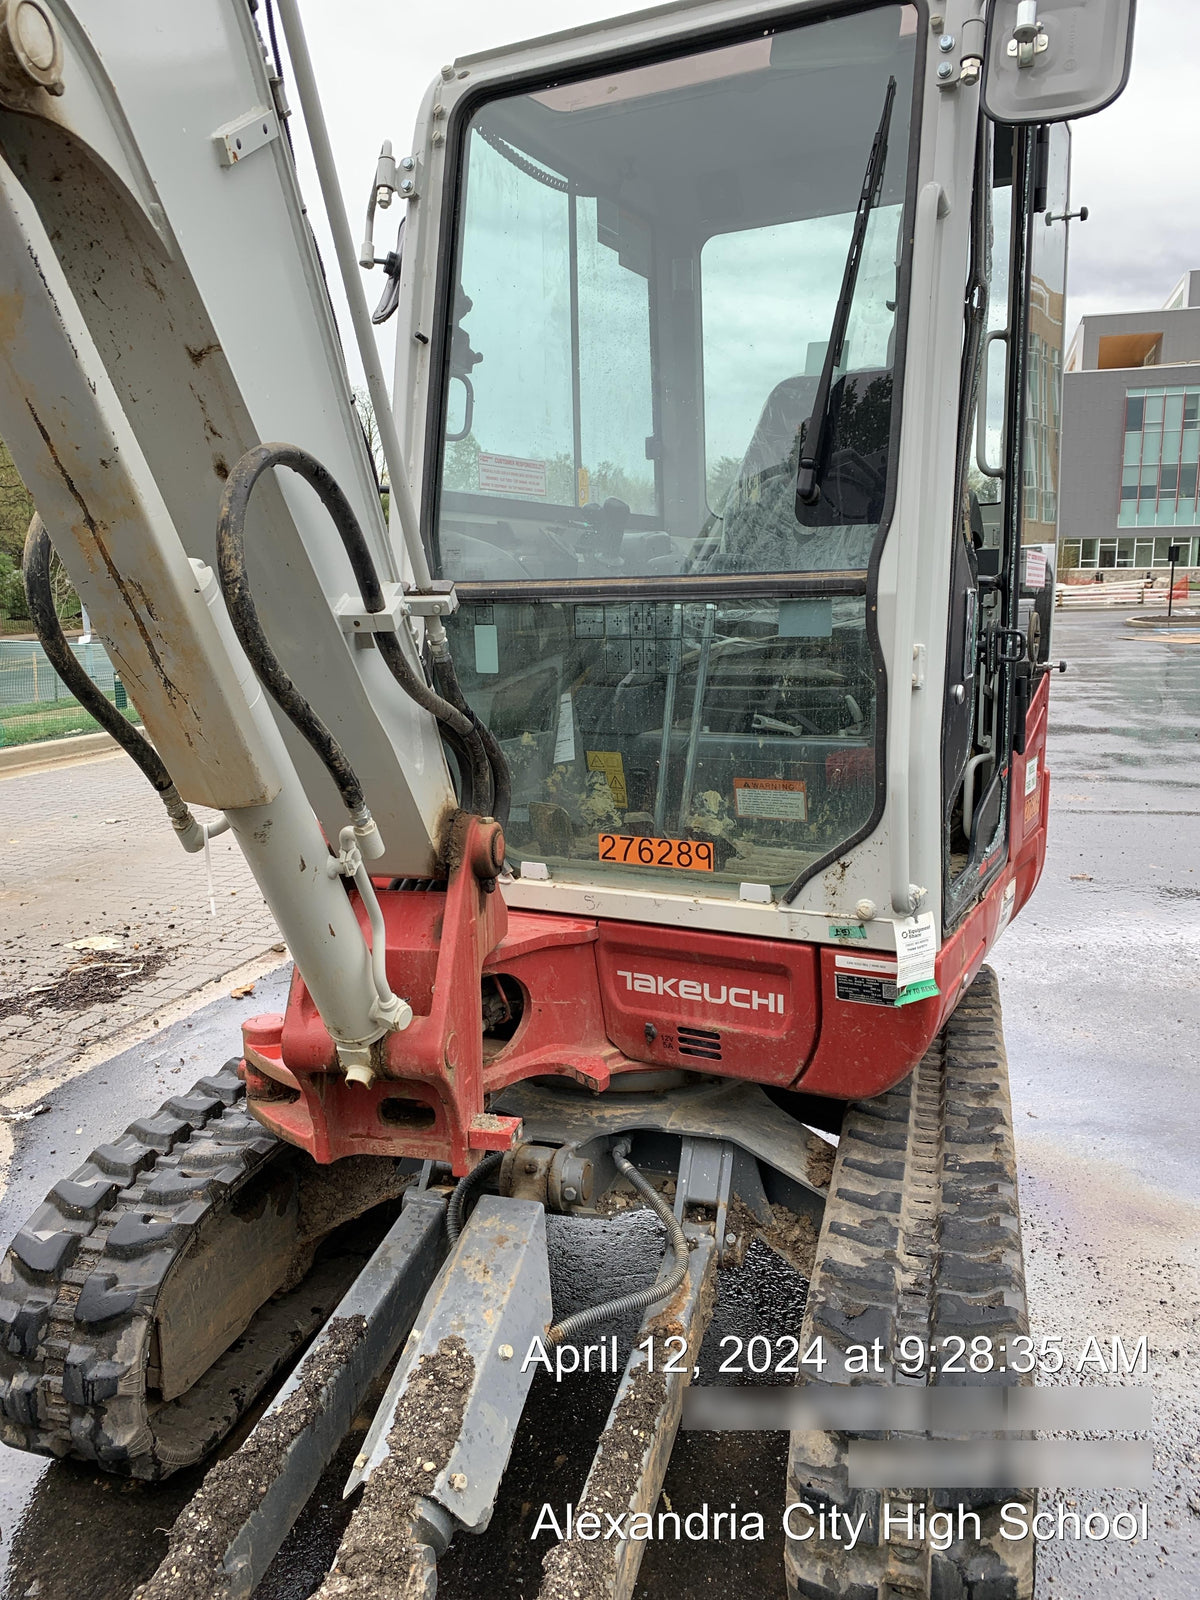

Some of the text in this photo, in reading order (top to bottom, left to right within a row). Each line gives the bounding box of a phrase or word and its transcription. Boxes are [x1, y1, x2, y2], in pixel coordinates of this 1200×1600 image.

[751, 781, 795, 791] WARNING
[600, 834, 713, 871] 276289
[908, 925, 931, 935] Equipment
[660, 1034, 674, 1043] 12V
[663, 1041, 674, 1050] 5A
